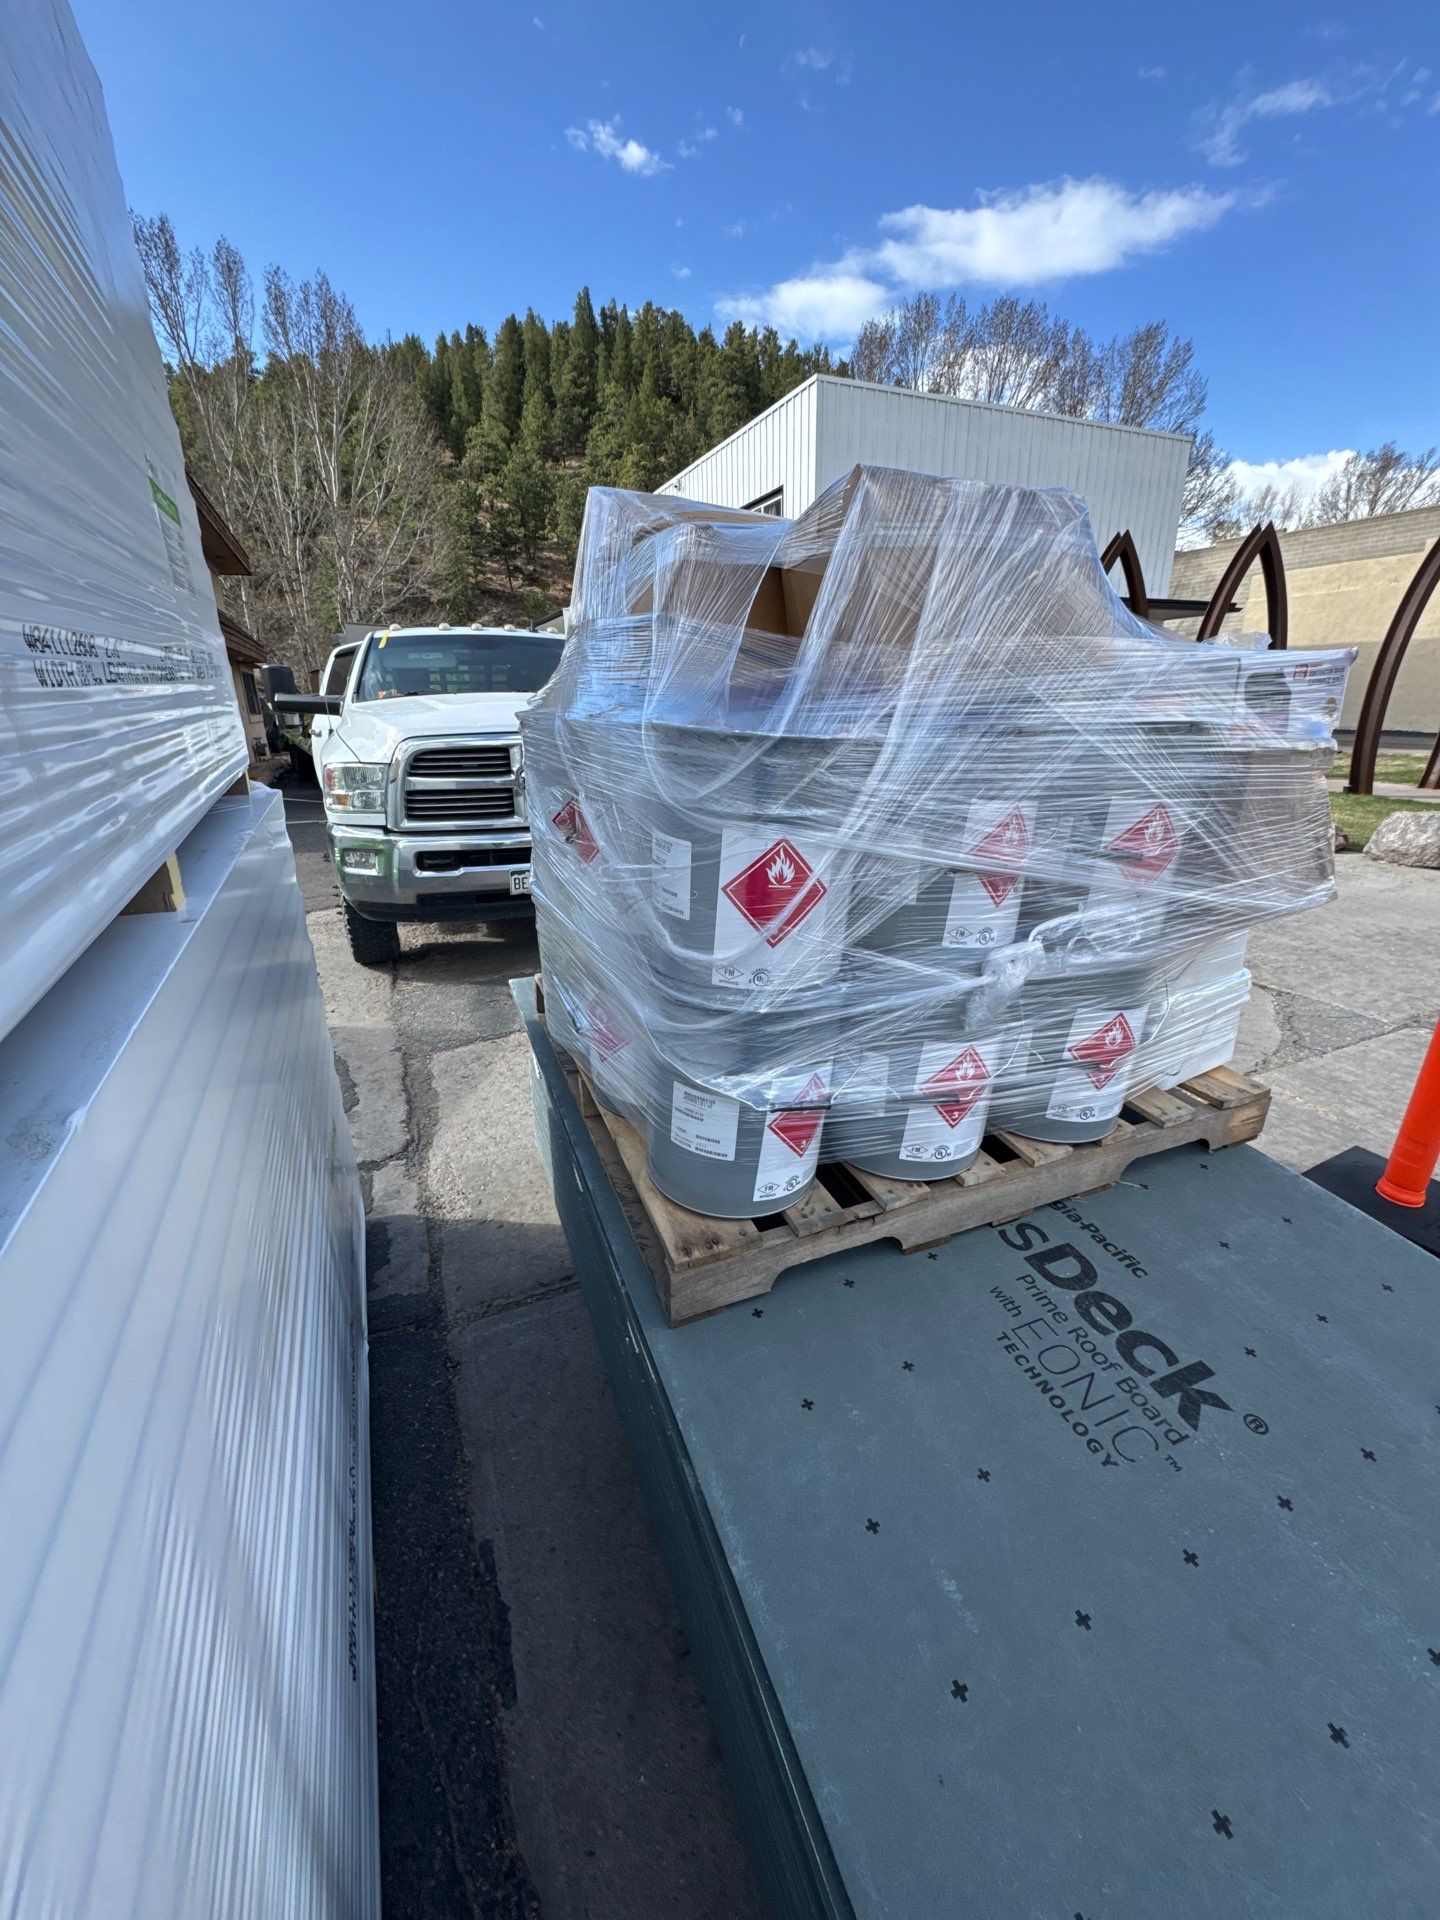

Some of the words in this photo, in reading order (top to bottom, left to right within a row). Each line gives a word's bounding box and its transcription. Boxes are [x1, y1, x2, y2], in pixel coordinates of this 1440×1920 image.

[33, 659, 78, 688] WIDTH
[514, 876, 529, 890] BE
[724, 968, 735, 977] FM
[1050, 1198, 1148, 1280] gia-Pacific
[989, 1285, 1023, 1319] with
[998, 1222, 1234, 1432] sDeck
[996, 1331, 1120, 1468] TECHNOLOGY
[1011, 1317, 1160, 1463] EONIC
[1016, 1273, 1069, 1325] Prime
[1068, 1325, 1123, 1374] Roof
[1115, 1376, 1191, 1446] Board
